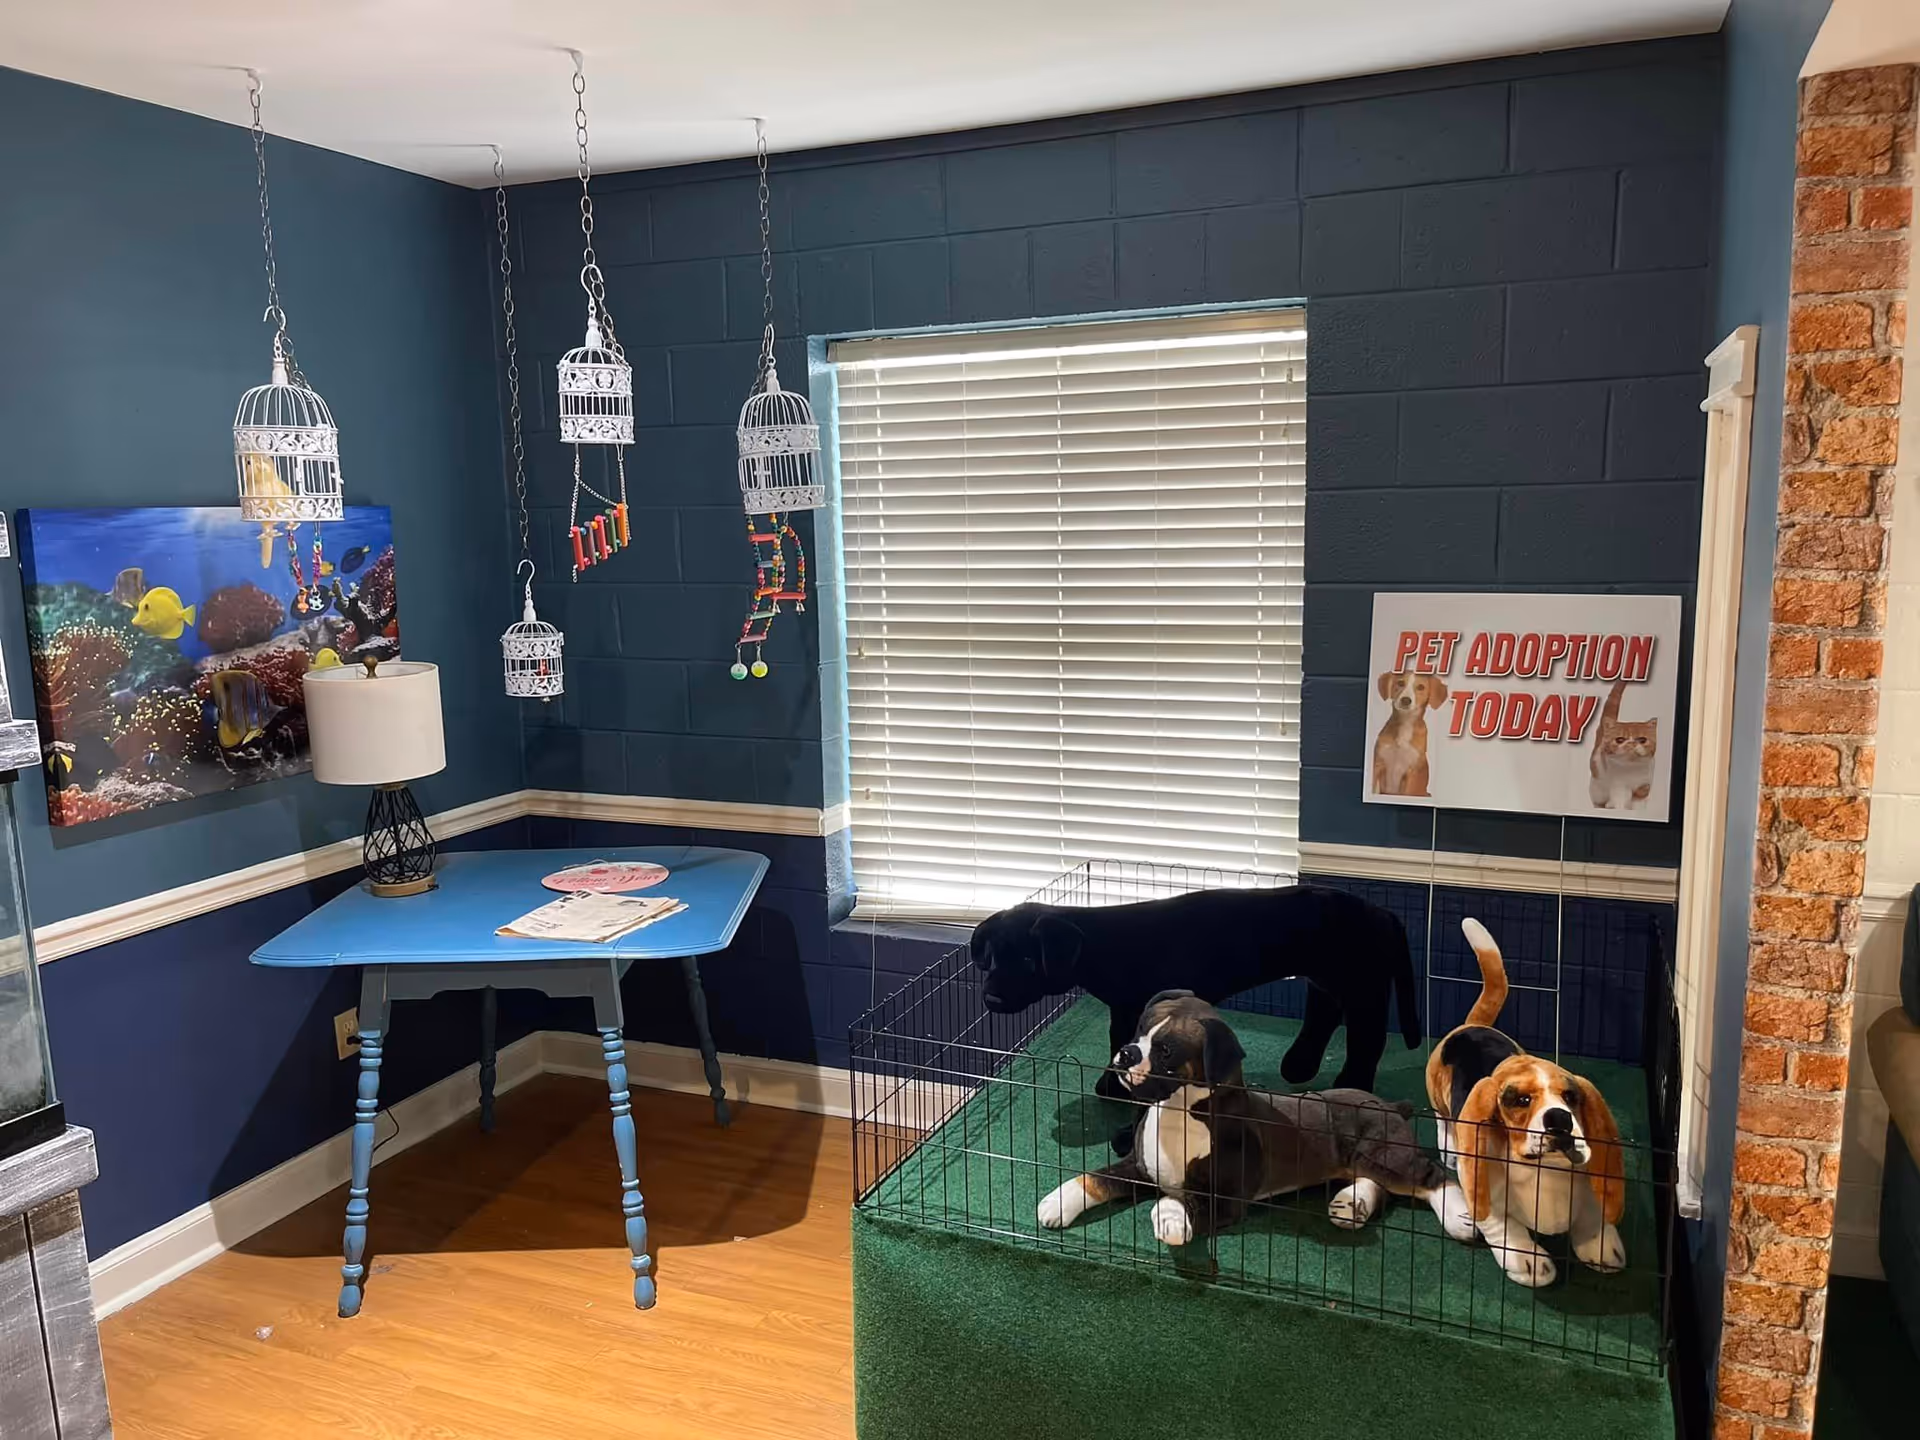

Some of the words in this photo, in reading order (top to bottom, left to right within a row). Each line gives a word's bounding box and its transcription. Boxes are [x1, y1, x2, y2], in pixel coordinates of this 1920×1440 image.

[1393, 631, 1461, 674] PET
[1465, 632, 1654, 681] ADOPTION
[1448, 690, 1600, 742] TODAY
